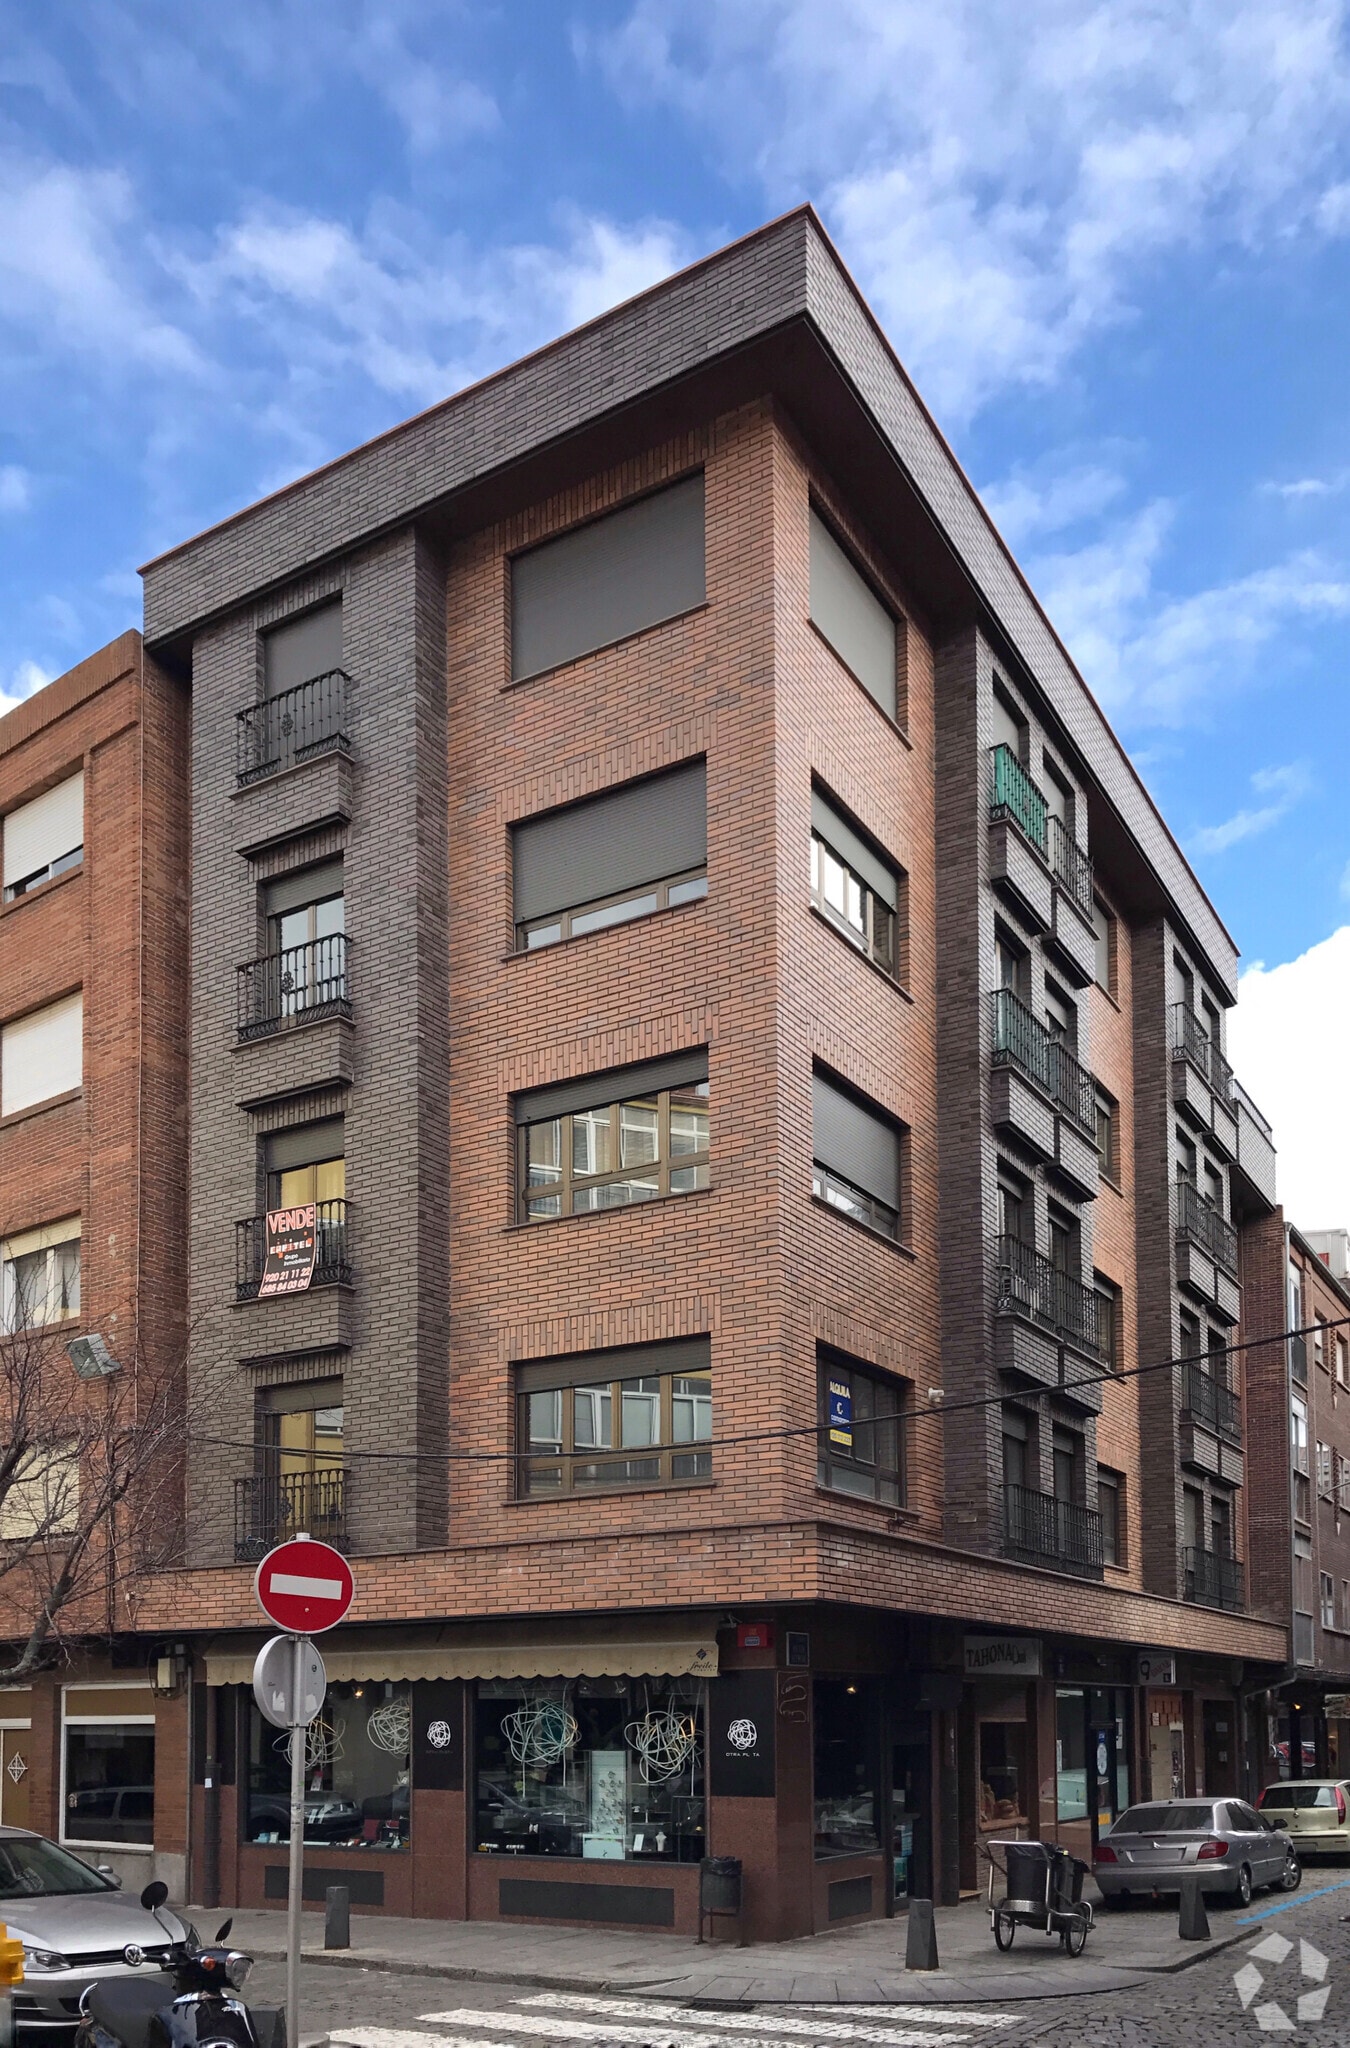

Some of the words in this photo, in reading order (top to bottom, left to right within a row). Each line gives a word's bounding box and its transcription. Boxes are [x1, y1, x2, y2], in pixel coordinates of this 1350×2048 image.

[269, 1207, 314, 1234] VENDE
[265, 1272, 280, 1283] 920
[279, 1270, 289, 1280] 21
[291, 1268, 300, 1279] 11
[300, 1266, 311, 1276] 22
[829, 1381, 851, 1399] ALQUILA
[966, 1643, 1014, 1667] TAHONA
